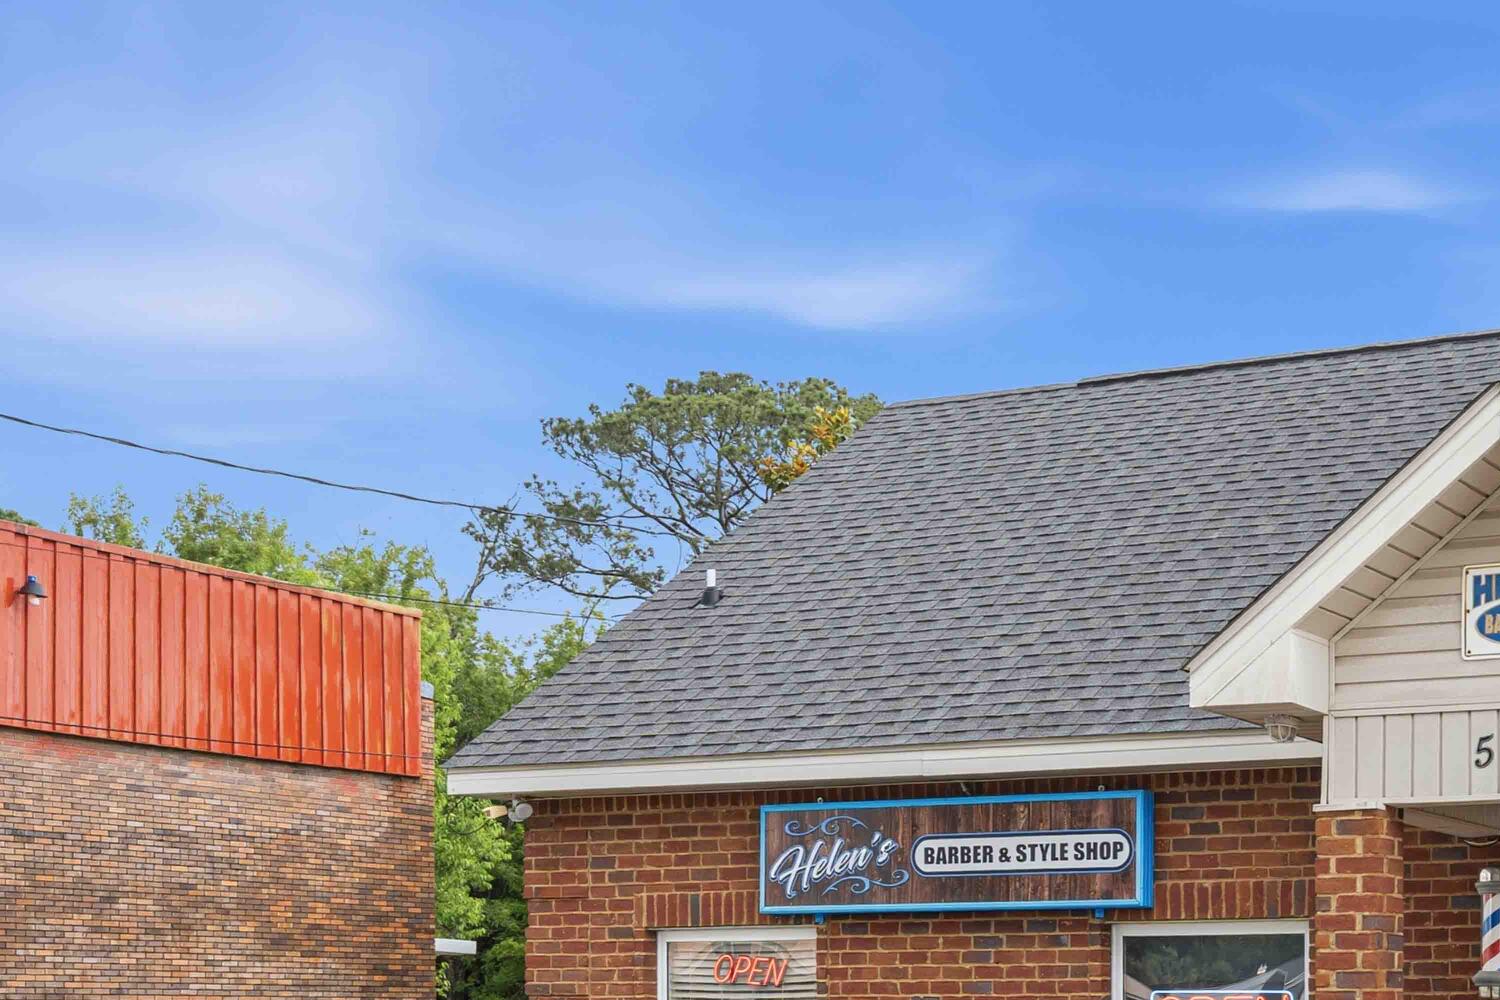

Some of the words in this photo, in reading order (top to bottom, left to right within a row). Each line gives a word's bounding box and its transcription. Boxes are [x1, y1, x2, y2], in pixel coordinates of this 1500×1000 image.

[769, 831, 899, 899] Helen's
[923, 844, 995, 865] BARBER
[998, 846, 1012, 863] &
[1015, 842, 1069, 863] STYLE
[1073, 840, 1124, 861] SHOP
[713, 954, 789, 987] OPEN
